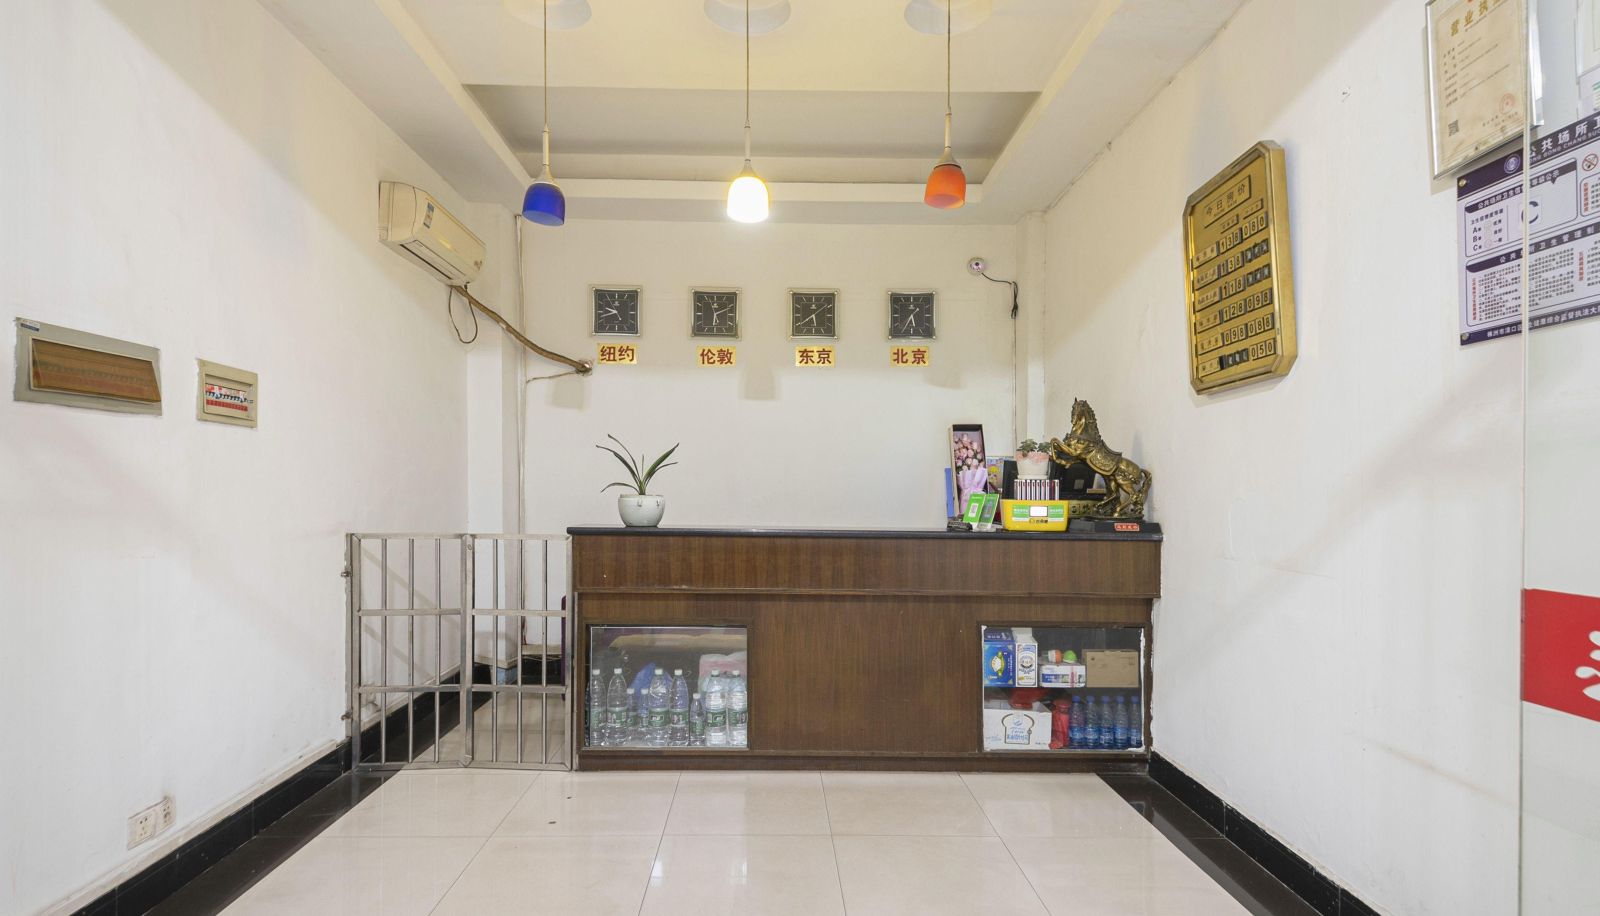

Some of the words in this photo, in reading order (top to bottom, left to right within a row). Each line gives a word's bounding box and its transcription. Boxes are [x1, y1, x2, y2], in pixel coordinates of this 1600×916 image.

[1450, 0, 1502, 36] 营业执
[1563, 135, 1587, 149] CHANG
[1206, 183, 1245, 216] 今日房价
[1222, 255, 1240, 271] 138
[1224, 279, 1241, 298] 118
[1225, 302, 1242, 318] 128
[1247, 292, 1268, 308] 098
[1225, 328, 1244, 343] 098
[1249, 316, 1270, 334] 088
[600, 345, 636, 363] 纽约
[700, 347, 734, 365] 伦敦
[798, 348, 833, 365] 东京
[892, 347, 927, 365] 北京
[1251, 342, 1273, 358] 050
